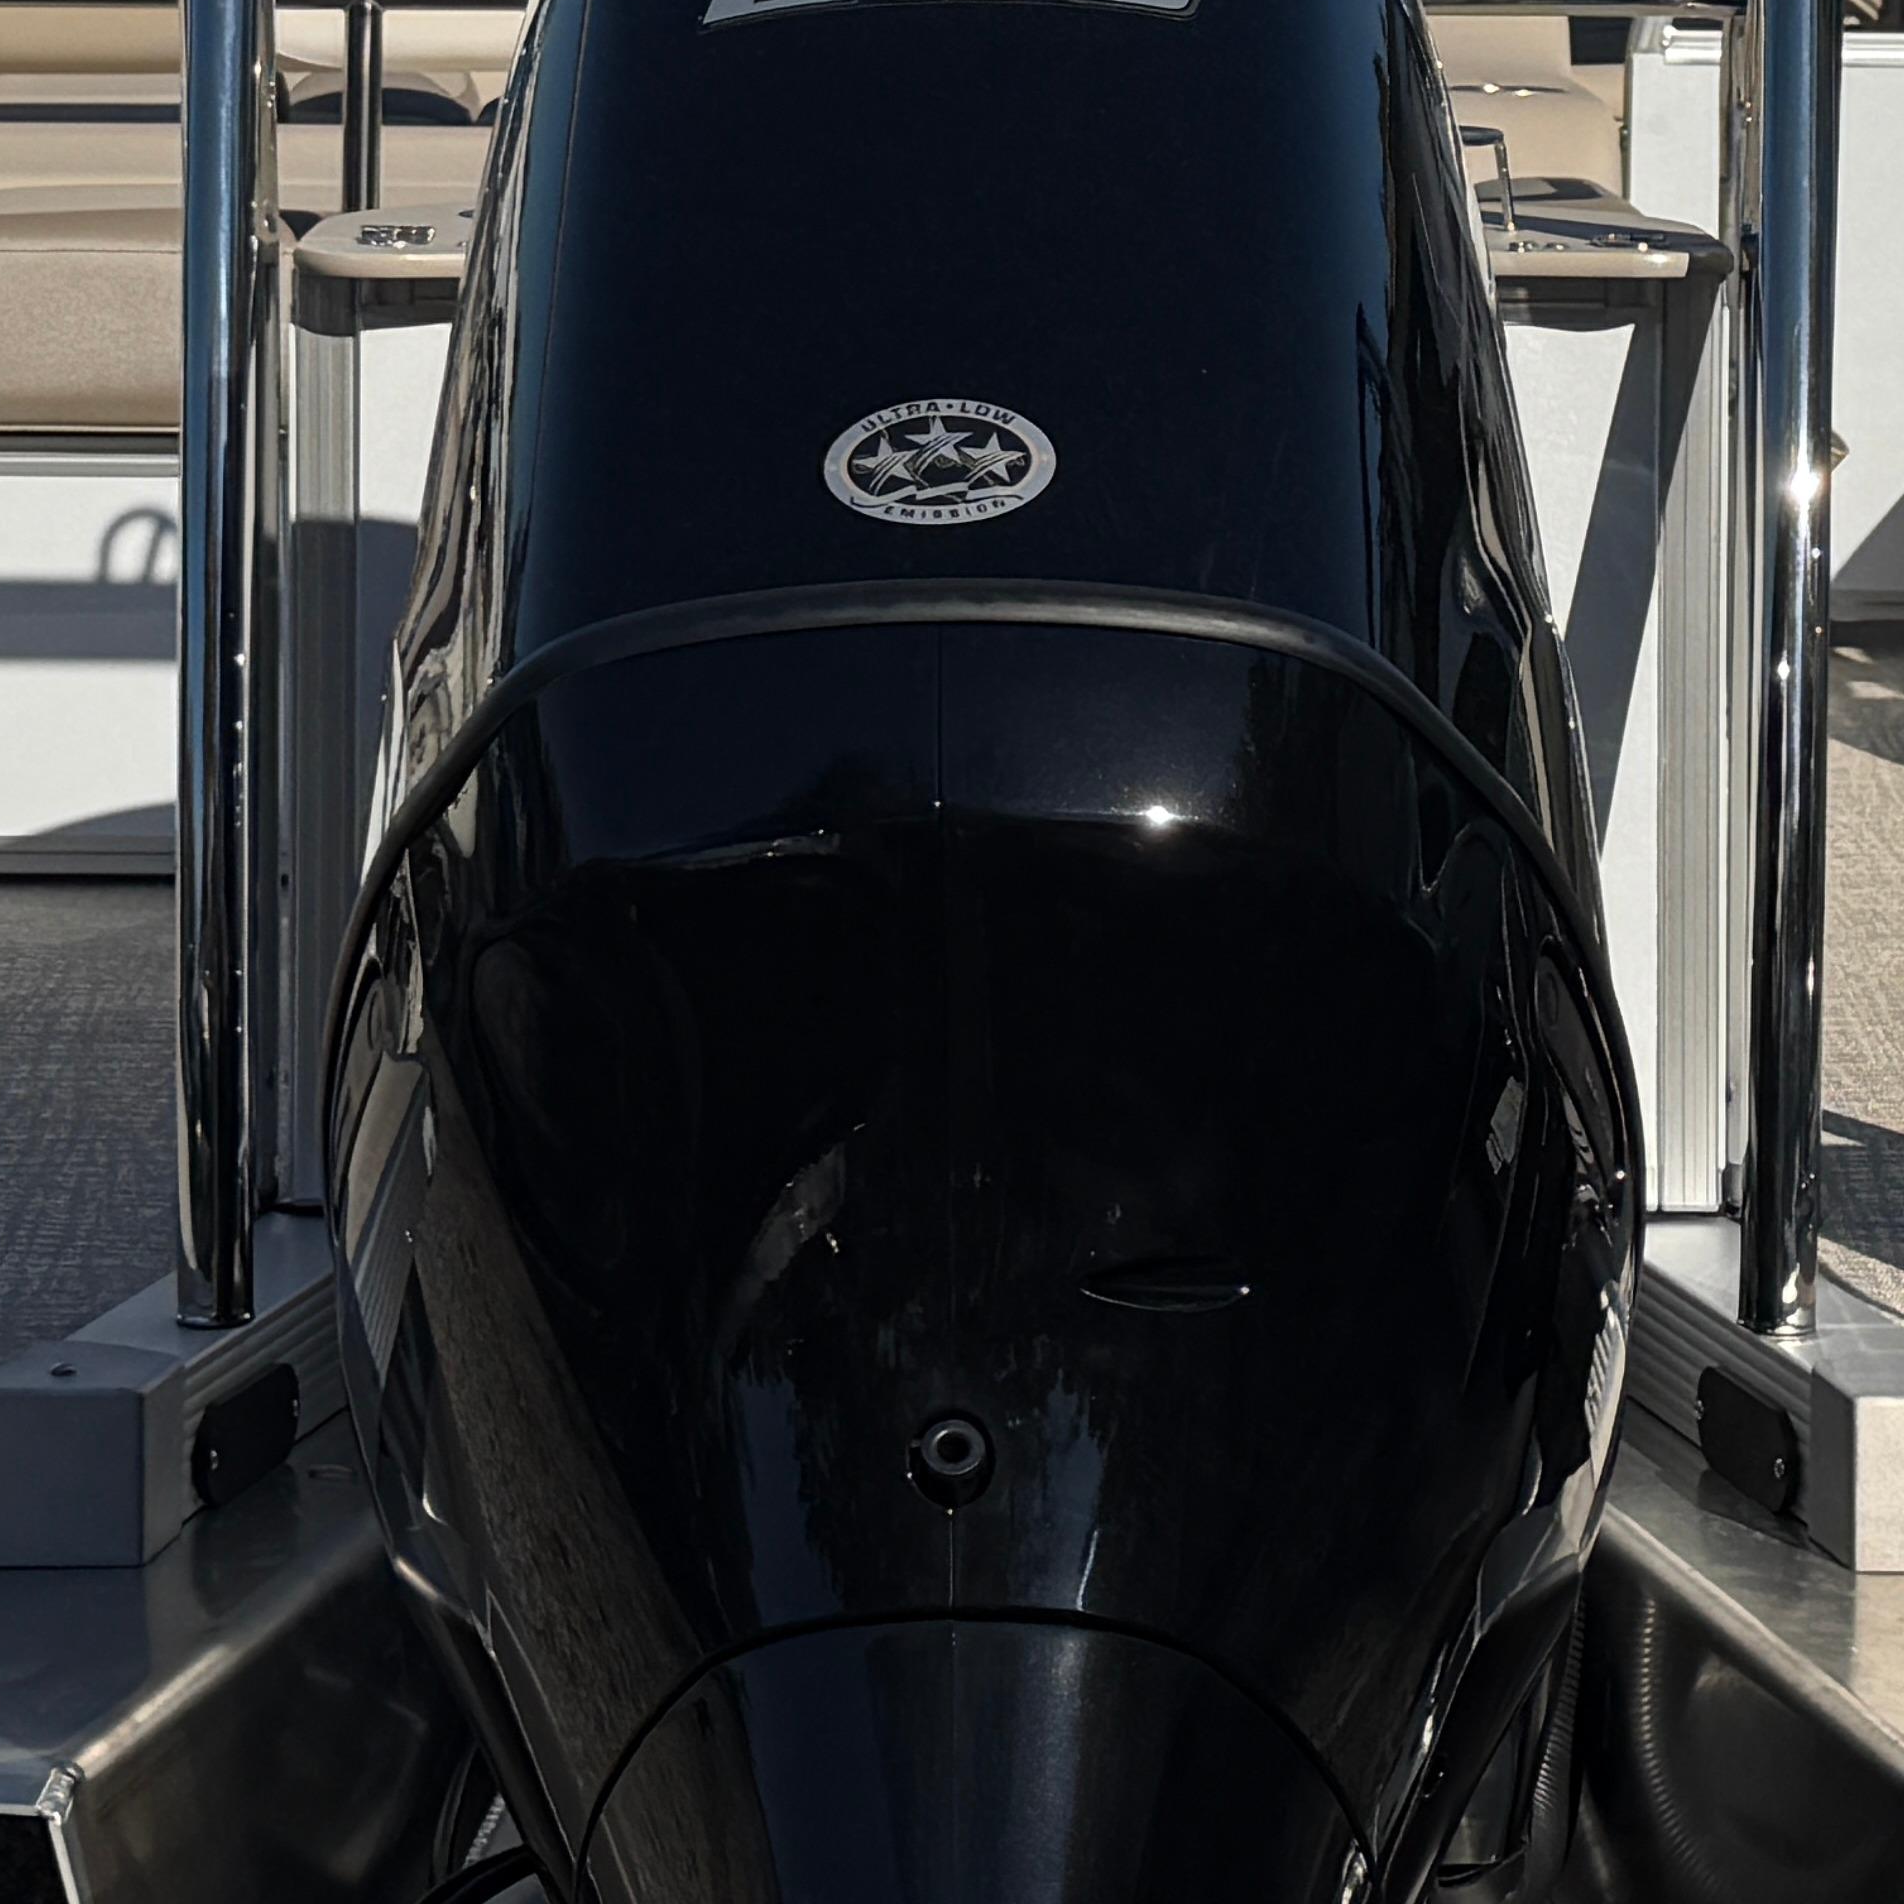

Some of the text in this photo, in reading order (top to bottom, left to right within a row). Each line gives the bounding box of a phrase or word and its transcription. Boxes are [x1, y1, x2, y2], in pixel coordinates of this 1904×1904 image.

[859, 400, 1016, 433] ULTRA LOW
[883, 499, 1005, 520] EMISSION
